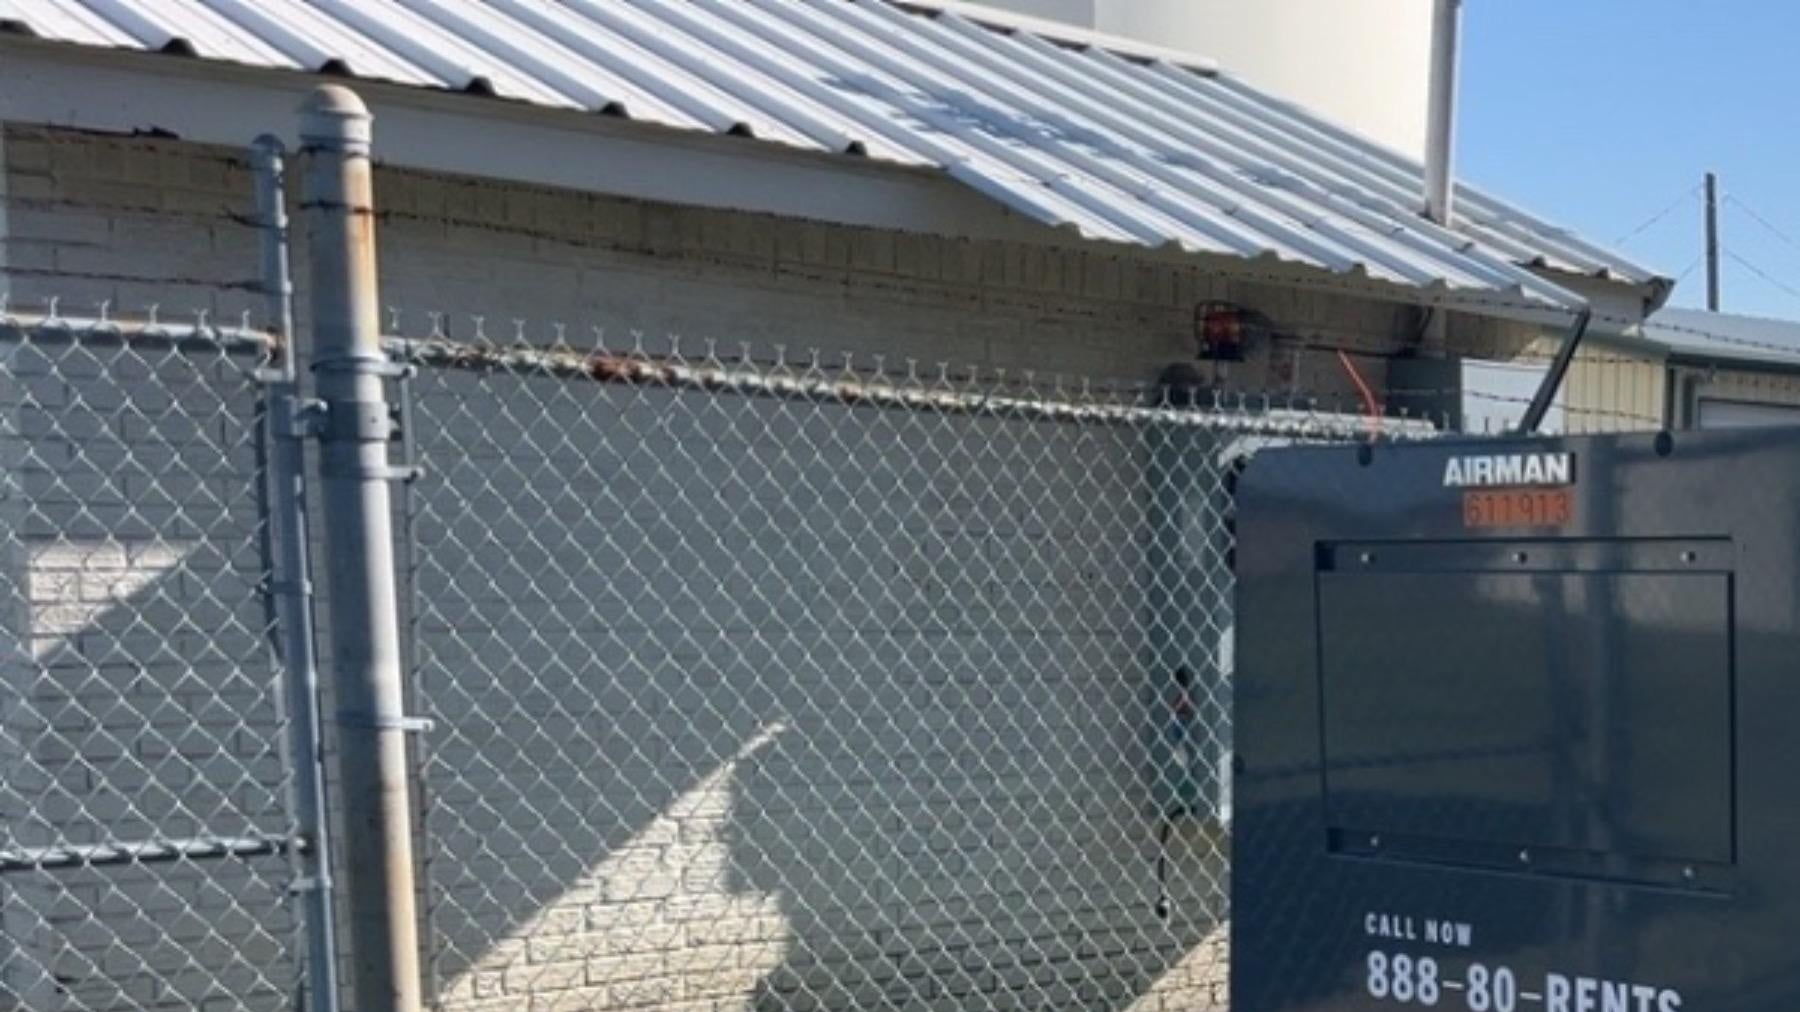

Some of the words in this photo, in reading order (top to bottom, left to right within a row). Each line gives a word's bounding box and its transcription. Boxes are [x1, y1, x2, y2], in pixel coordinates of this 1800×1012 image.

[1442, 453, 1569, 487] AIRMAN
[1466, 493, 1570, 523] 611913
[1365, 912, 1417, 940] CALL
[1424, 919, 1472, 946] NOW
